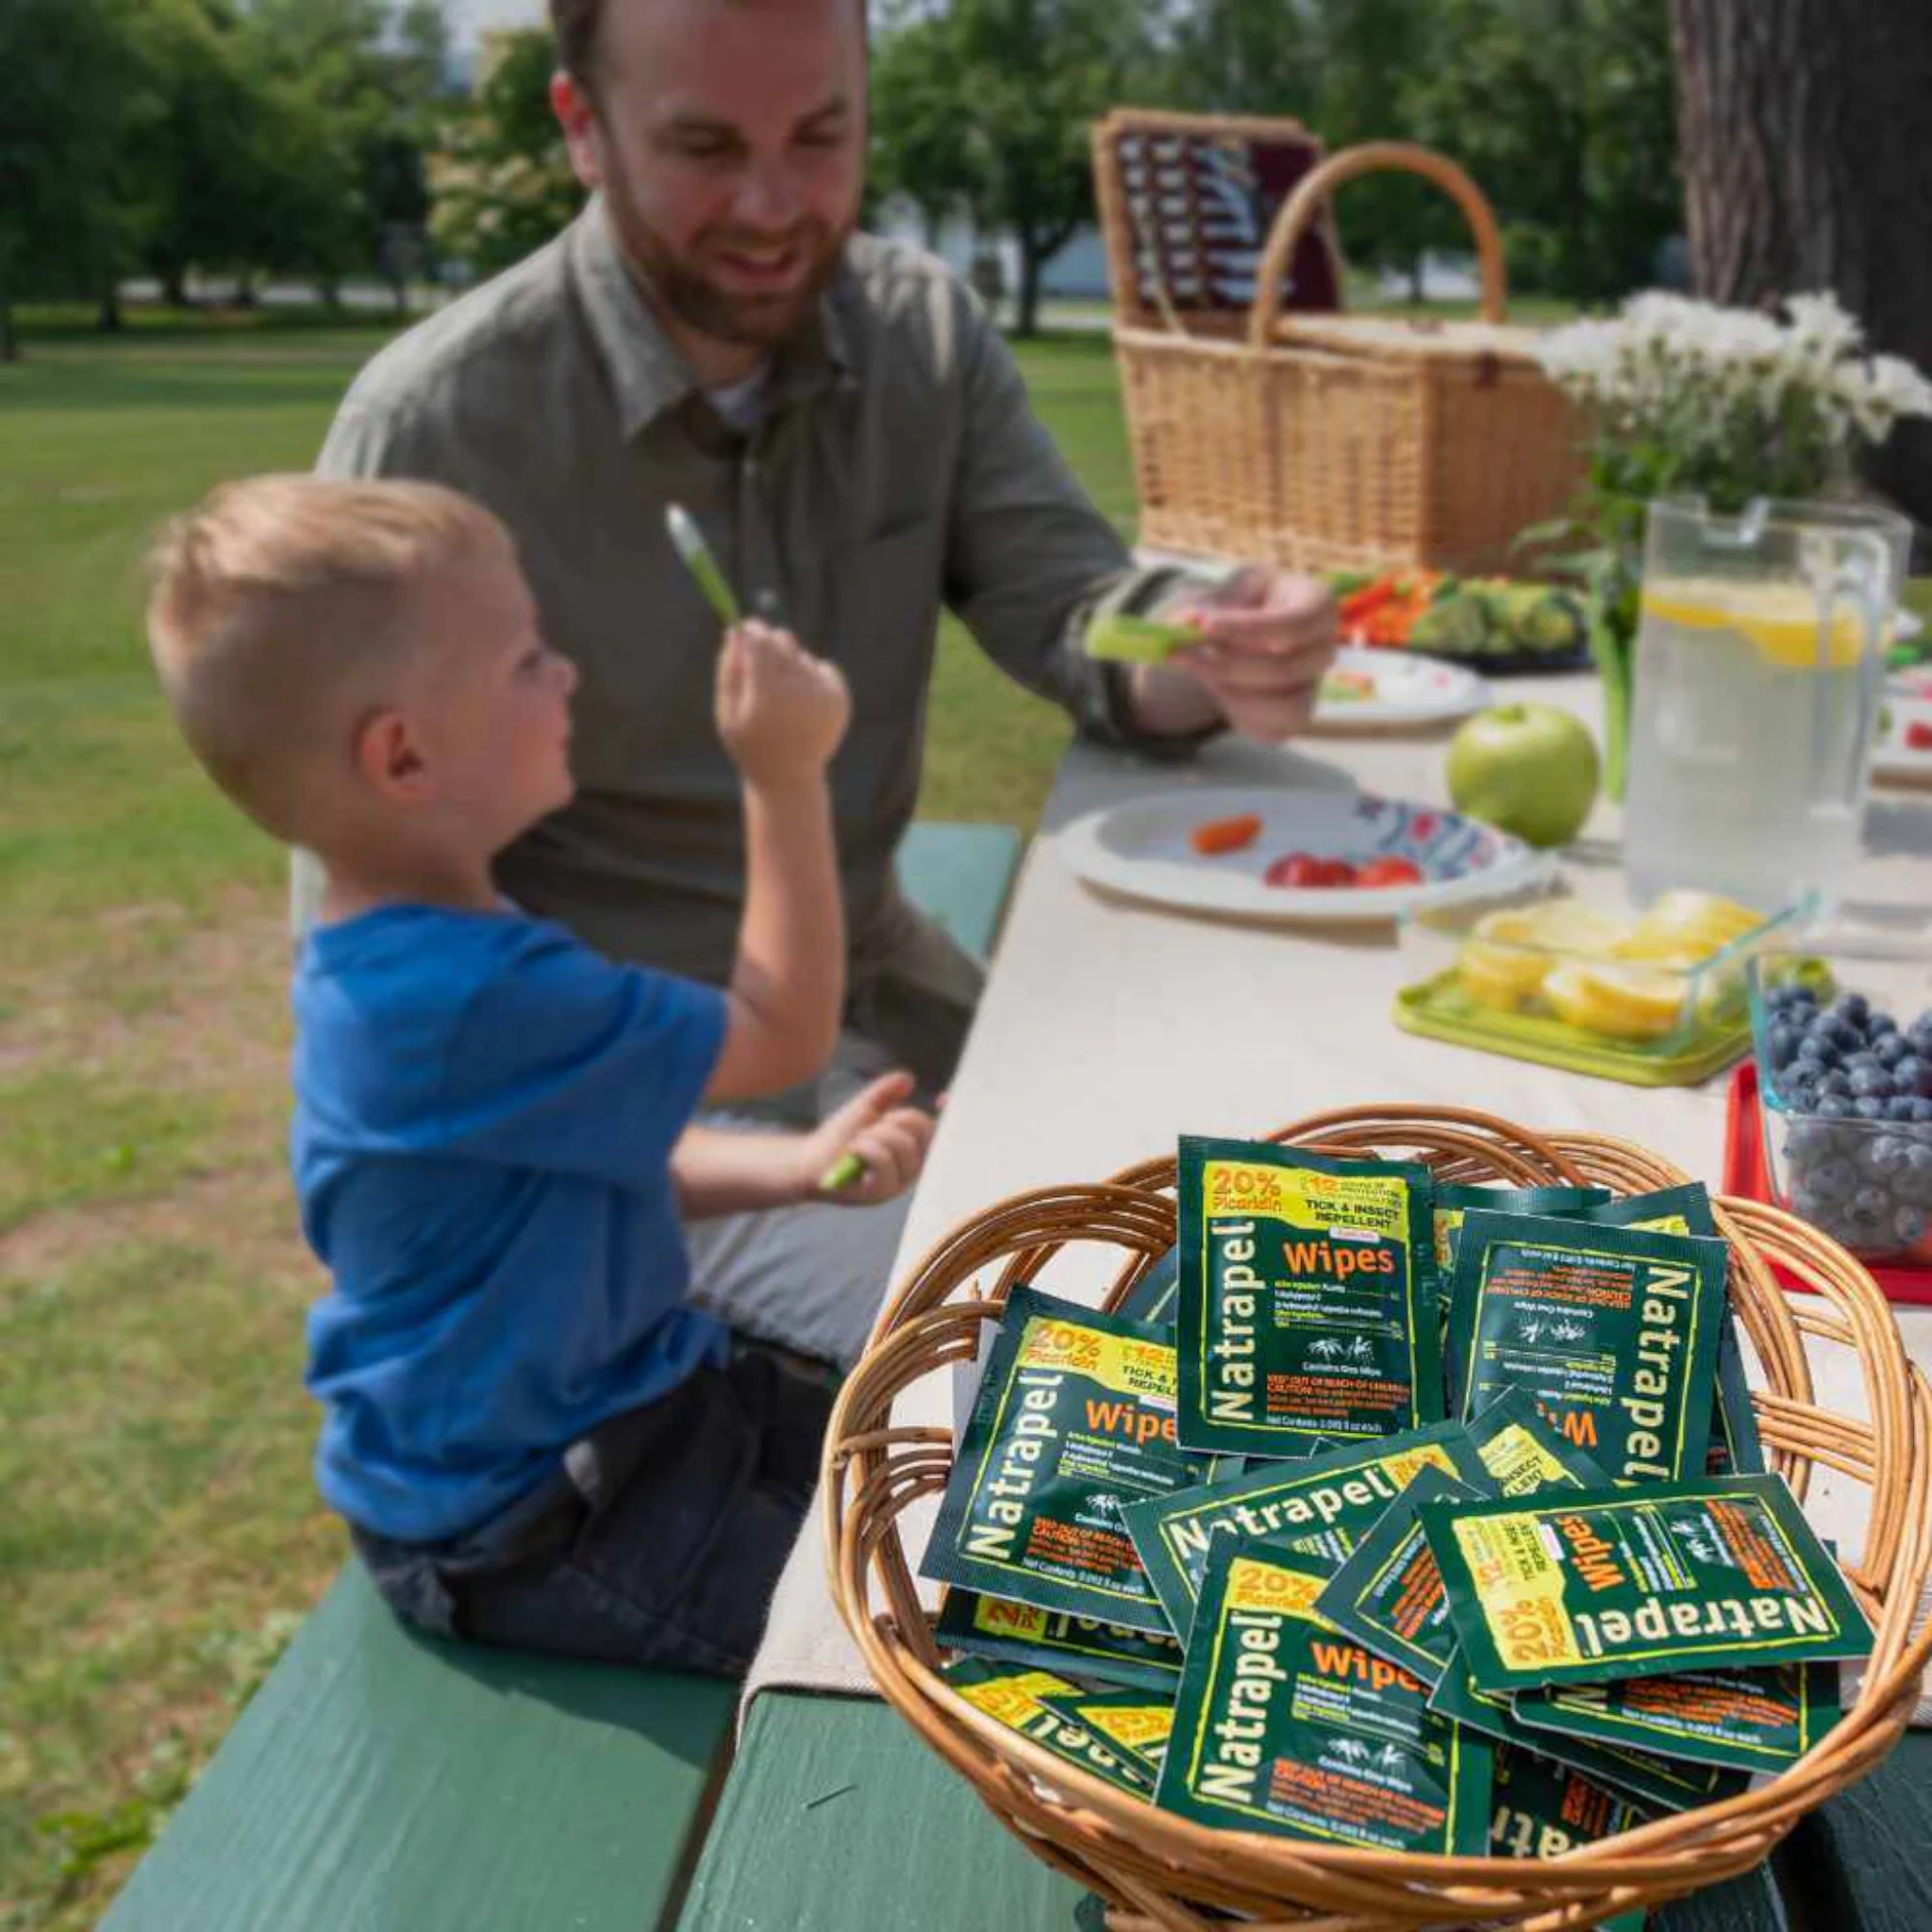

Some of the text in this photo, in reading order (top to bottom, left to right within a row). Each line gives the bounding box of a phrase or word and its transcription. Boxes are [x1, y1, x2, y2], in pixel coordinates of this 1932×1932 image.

[1213, 1167, 1282, 1197] 20%
[1306, 1199, 1339, 1212] TICK
[1353, 1205, 1400, 1222] INSECT
[1315, 1212, 1393, 1229] REPELLENT
[1282, 1239, 1395, 1281] Wipes
[1028, 1323, 1101, 1358] 20%
[1209, 1220, 1267, 1422] Natrapel
[1123, 1366, 1155, 1383] TICK
[1620, 1267, 1692, 1482] Natrapel
[1086, 1399, 1177, 1443] Wipe
[965, 1370, 1065, 1559] Natrapel
[1555, 1514, 1625, 1591] Wipes
[1239, 1567, 1319, 1601] 20%
[1505, 1598, 1548, 1663] 20%
[1574, 1596, 1828, 1657] Natrapel
[1309, 1641, 1420, 1691] Wipe
[1198, 1610, 1289, 1804] Natrapel
